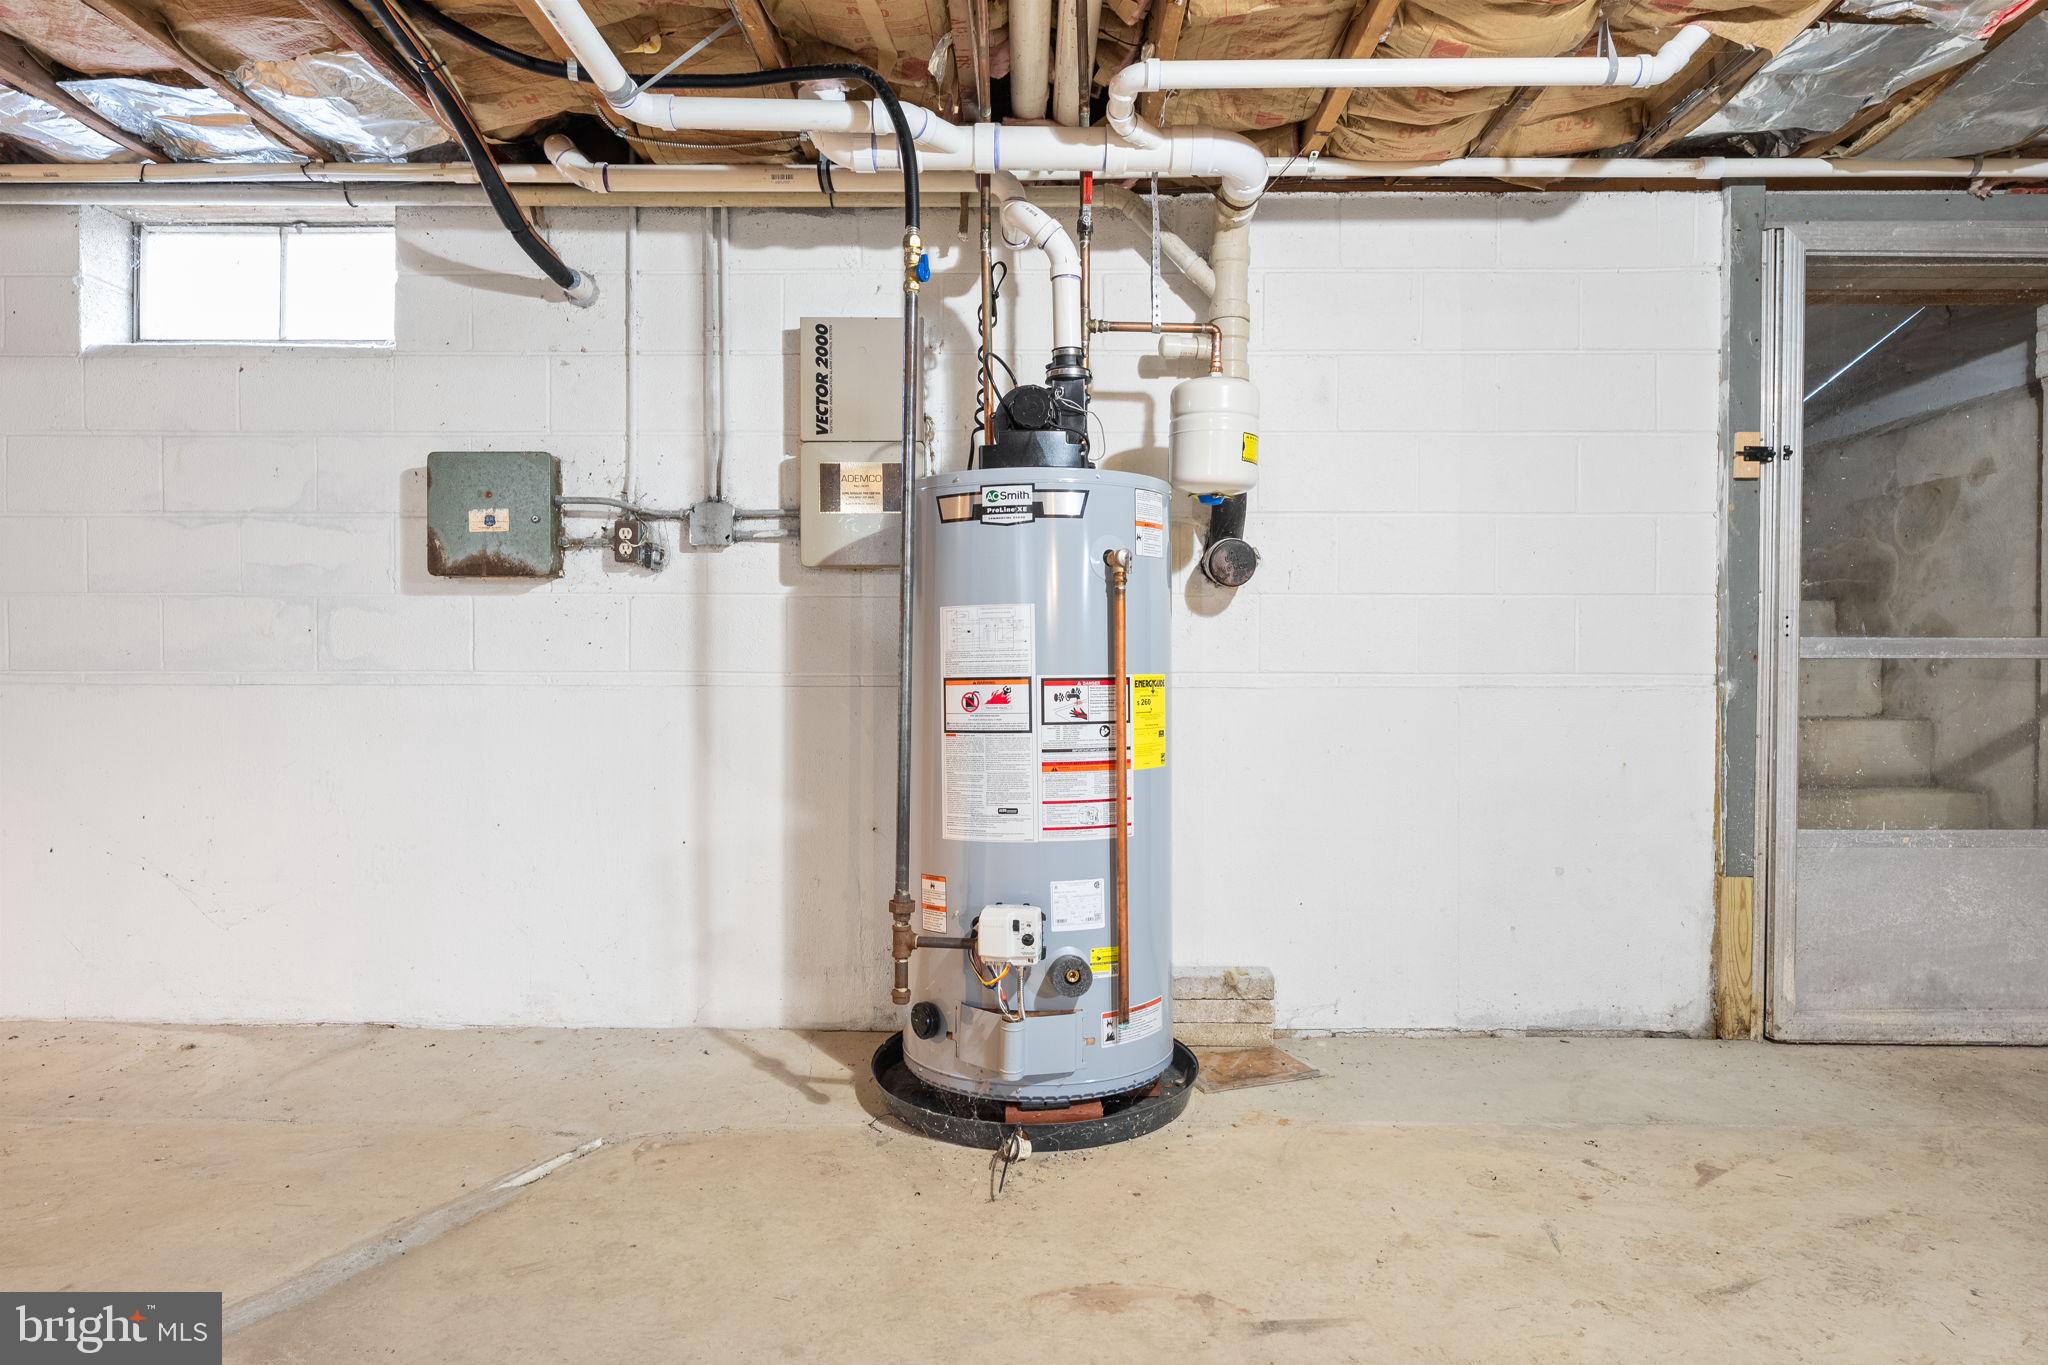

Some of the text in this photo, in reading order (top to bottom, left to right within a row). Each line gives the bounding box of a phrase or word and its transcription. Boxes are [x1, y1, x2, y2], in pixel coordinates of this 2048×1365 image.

[815, 323, 829, 436] VECTOR 2000
[841, 474, 883, 483] ADEMCO
[1000, 490, 1030, 500] Smith
